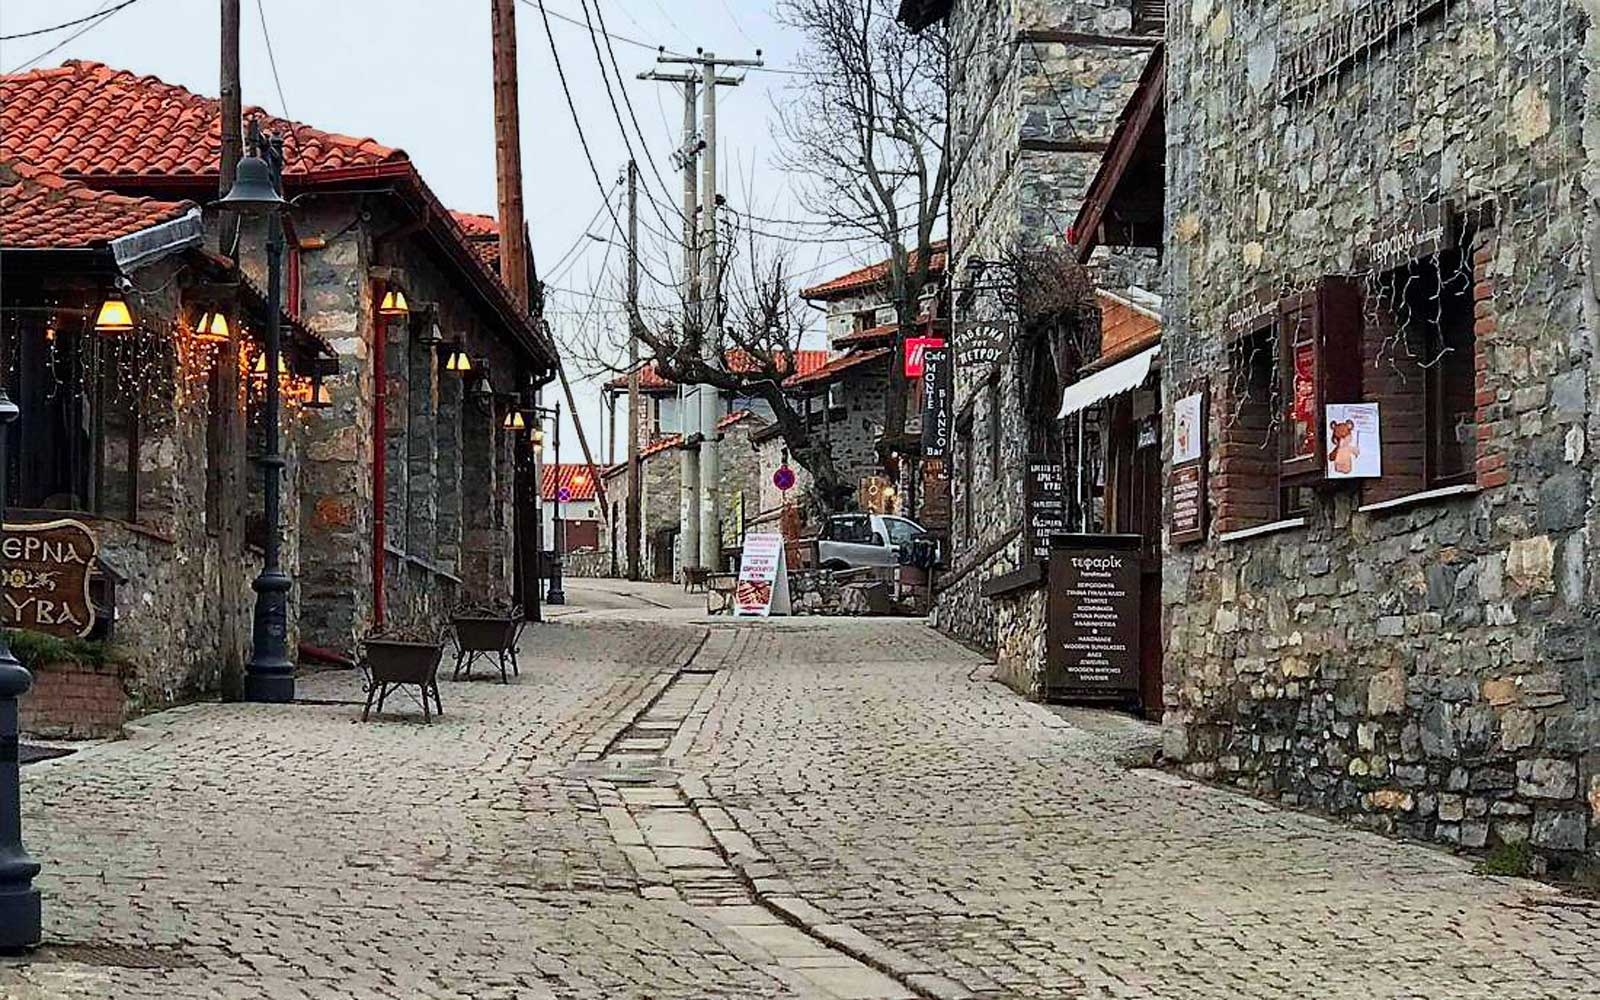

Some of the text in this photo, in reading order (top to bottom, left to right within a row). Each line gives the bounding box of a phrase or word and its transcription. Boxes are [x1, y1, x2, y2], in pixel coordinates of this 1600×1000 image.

[954, 326, 1005, 347] ΤΑΒΕΡΝΑ
[958, 348, 1003, 365] ΠΕΤΡΟΥ
[925, 363, 936, 409] MONTE
[936, 389, 946, 447] BIANCO
[926, 447, 943, 456] Bar
[0, 593, 82, 626] ΥΒΑ
